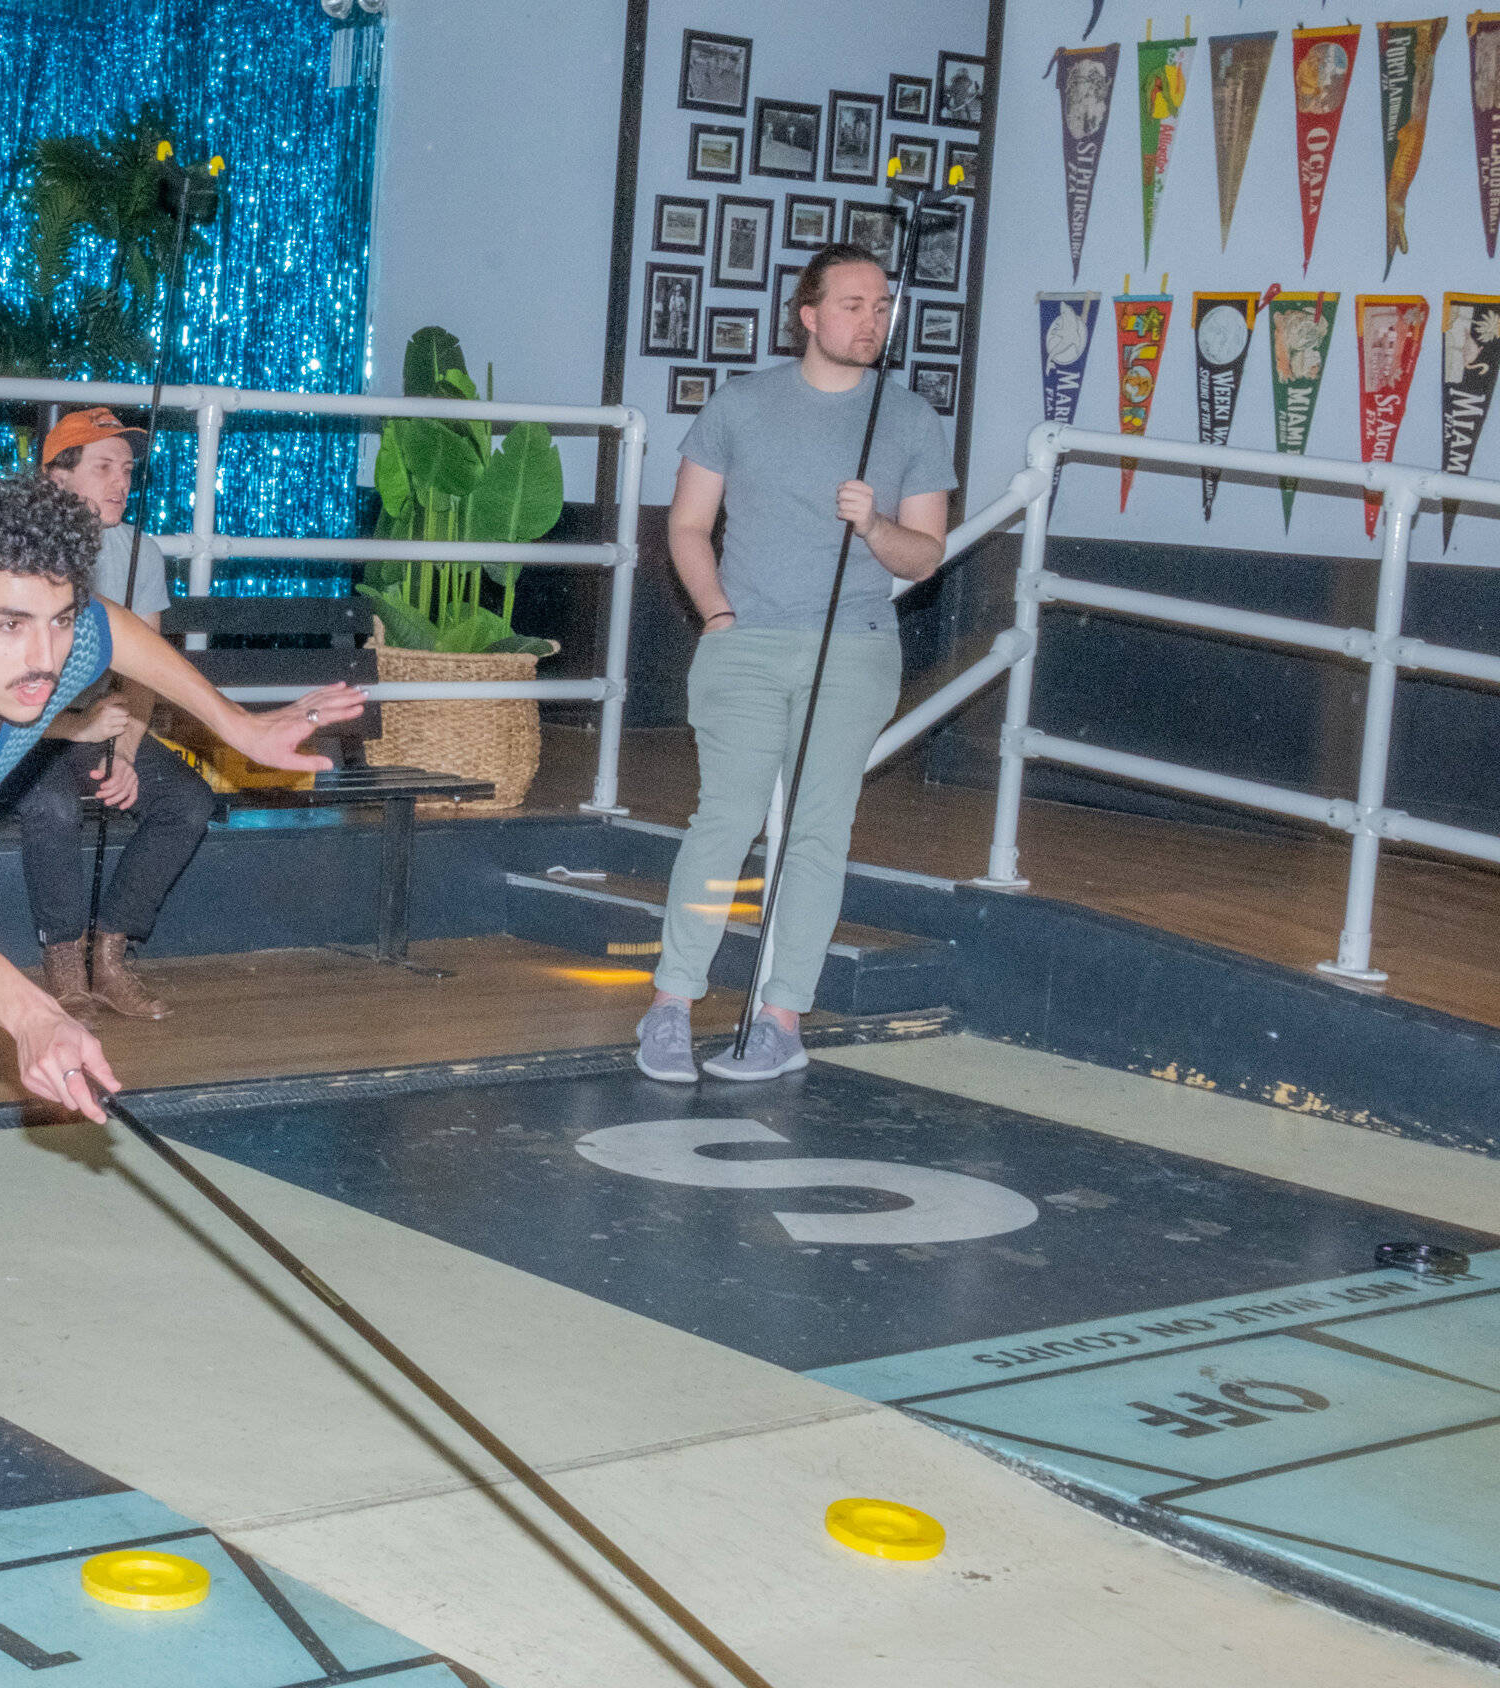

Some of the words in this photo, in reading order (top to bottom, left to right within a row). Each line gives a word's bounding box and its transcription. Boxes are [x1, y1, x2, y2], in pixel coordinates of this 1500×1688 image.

[1385, 35, 1411, 76] FORT
[1306, 127, 1330, 214] OCALA
[1072, 167, 1091, 258] PETERSBURG
[1199, 367, 1210, 398] SPRING
[1211, 370, 1234, 420] WEEKI
[1200, 401, 1210, 411] OF
[1201, 413, 1211, 429] THE
[1287, 386, 1313, 445] MIAMI
[1374, 394, 1401, 416] ST.
[1447, 387, 1486, 473] MIAM
[574, 1118, 1039, 1244] S
[1210, 1298, 1331, 1325] WALK
[1326, 1281, 1419, 1304] NOT
[1137, 1318, 1217, 1338] ON
[972, 1331, 1141, 1369] COURTS
[1126, 1380, 1330, 1438] OFF
